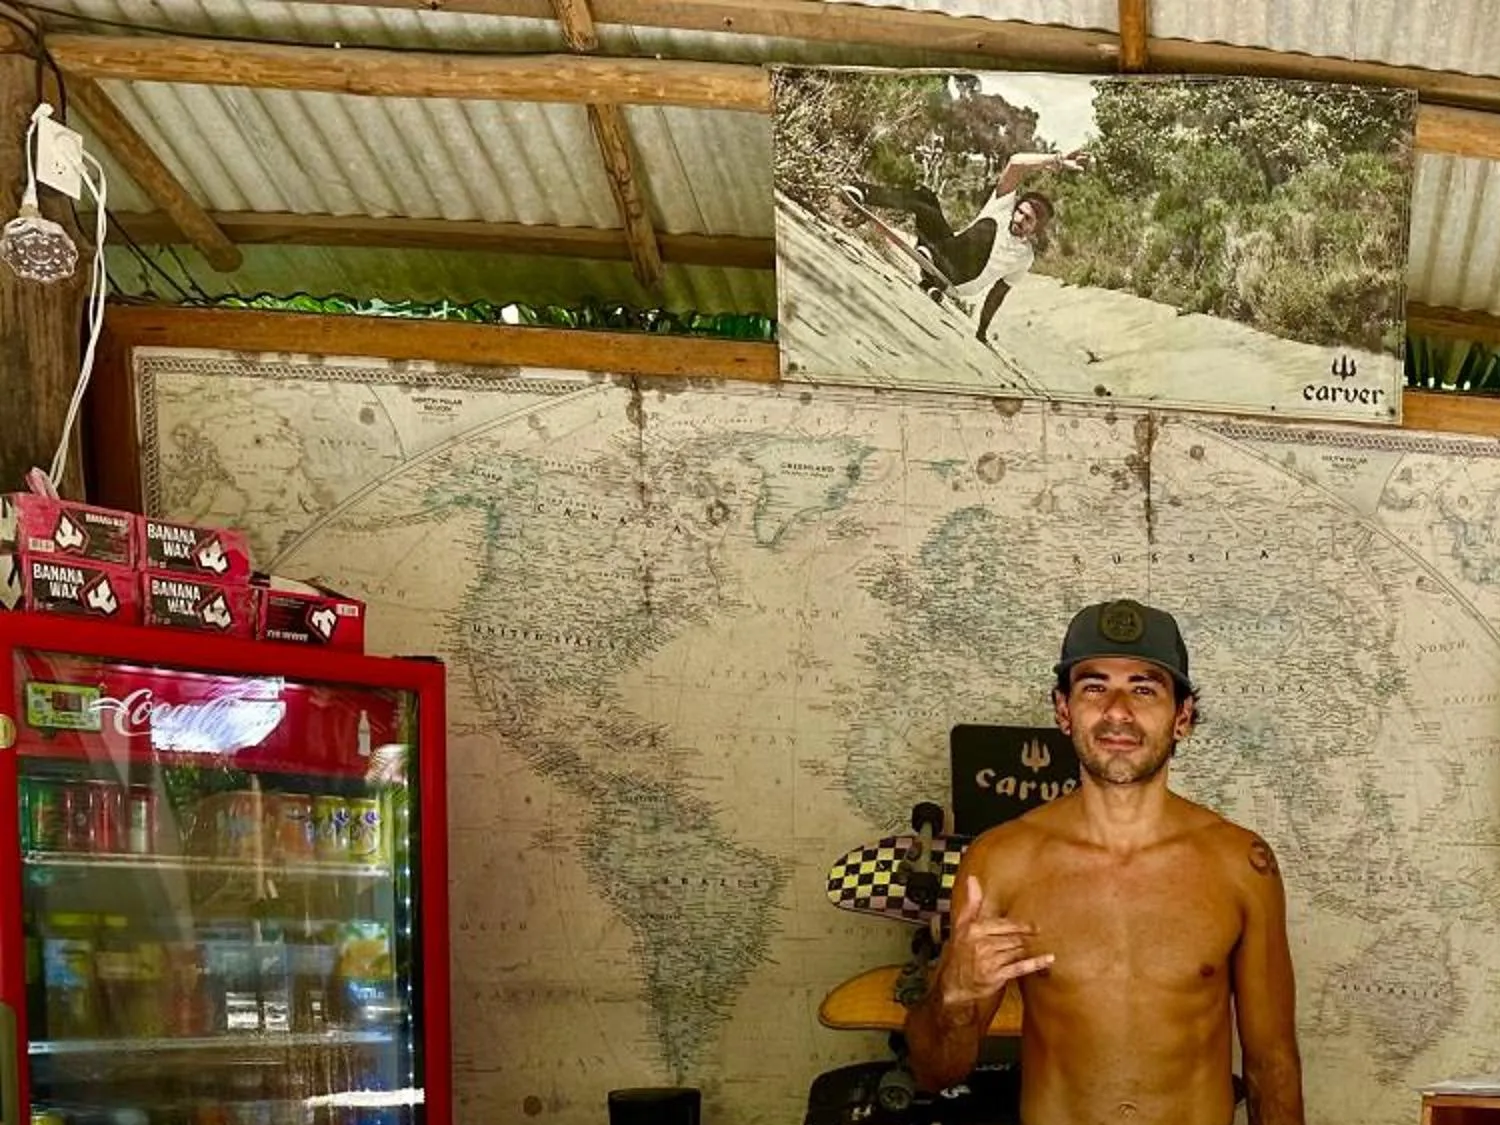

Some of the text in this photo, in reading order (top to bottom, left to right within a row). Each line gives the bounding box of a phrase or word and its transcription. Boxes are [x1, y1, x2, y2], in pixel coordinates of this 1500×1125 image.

[1303, 382, 1385, 405] carver
[147, 524, 197, 559] BANANA WAX
[33, 564, 84, 600] BANANA WAX
[152, 580, 200, 617] BANANA WAX
[975, 767, 1078, 801] carve
